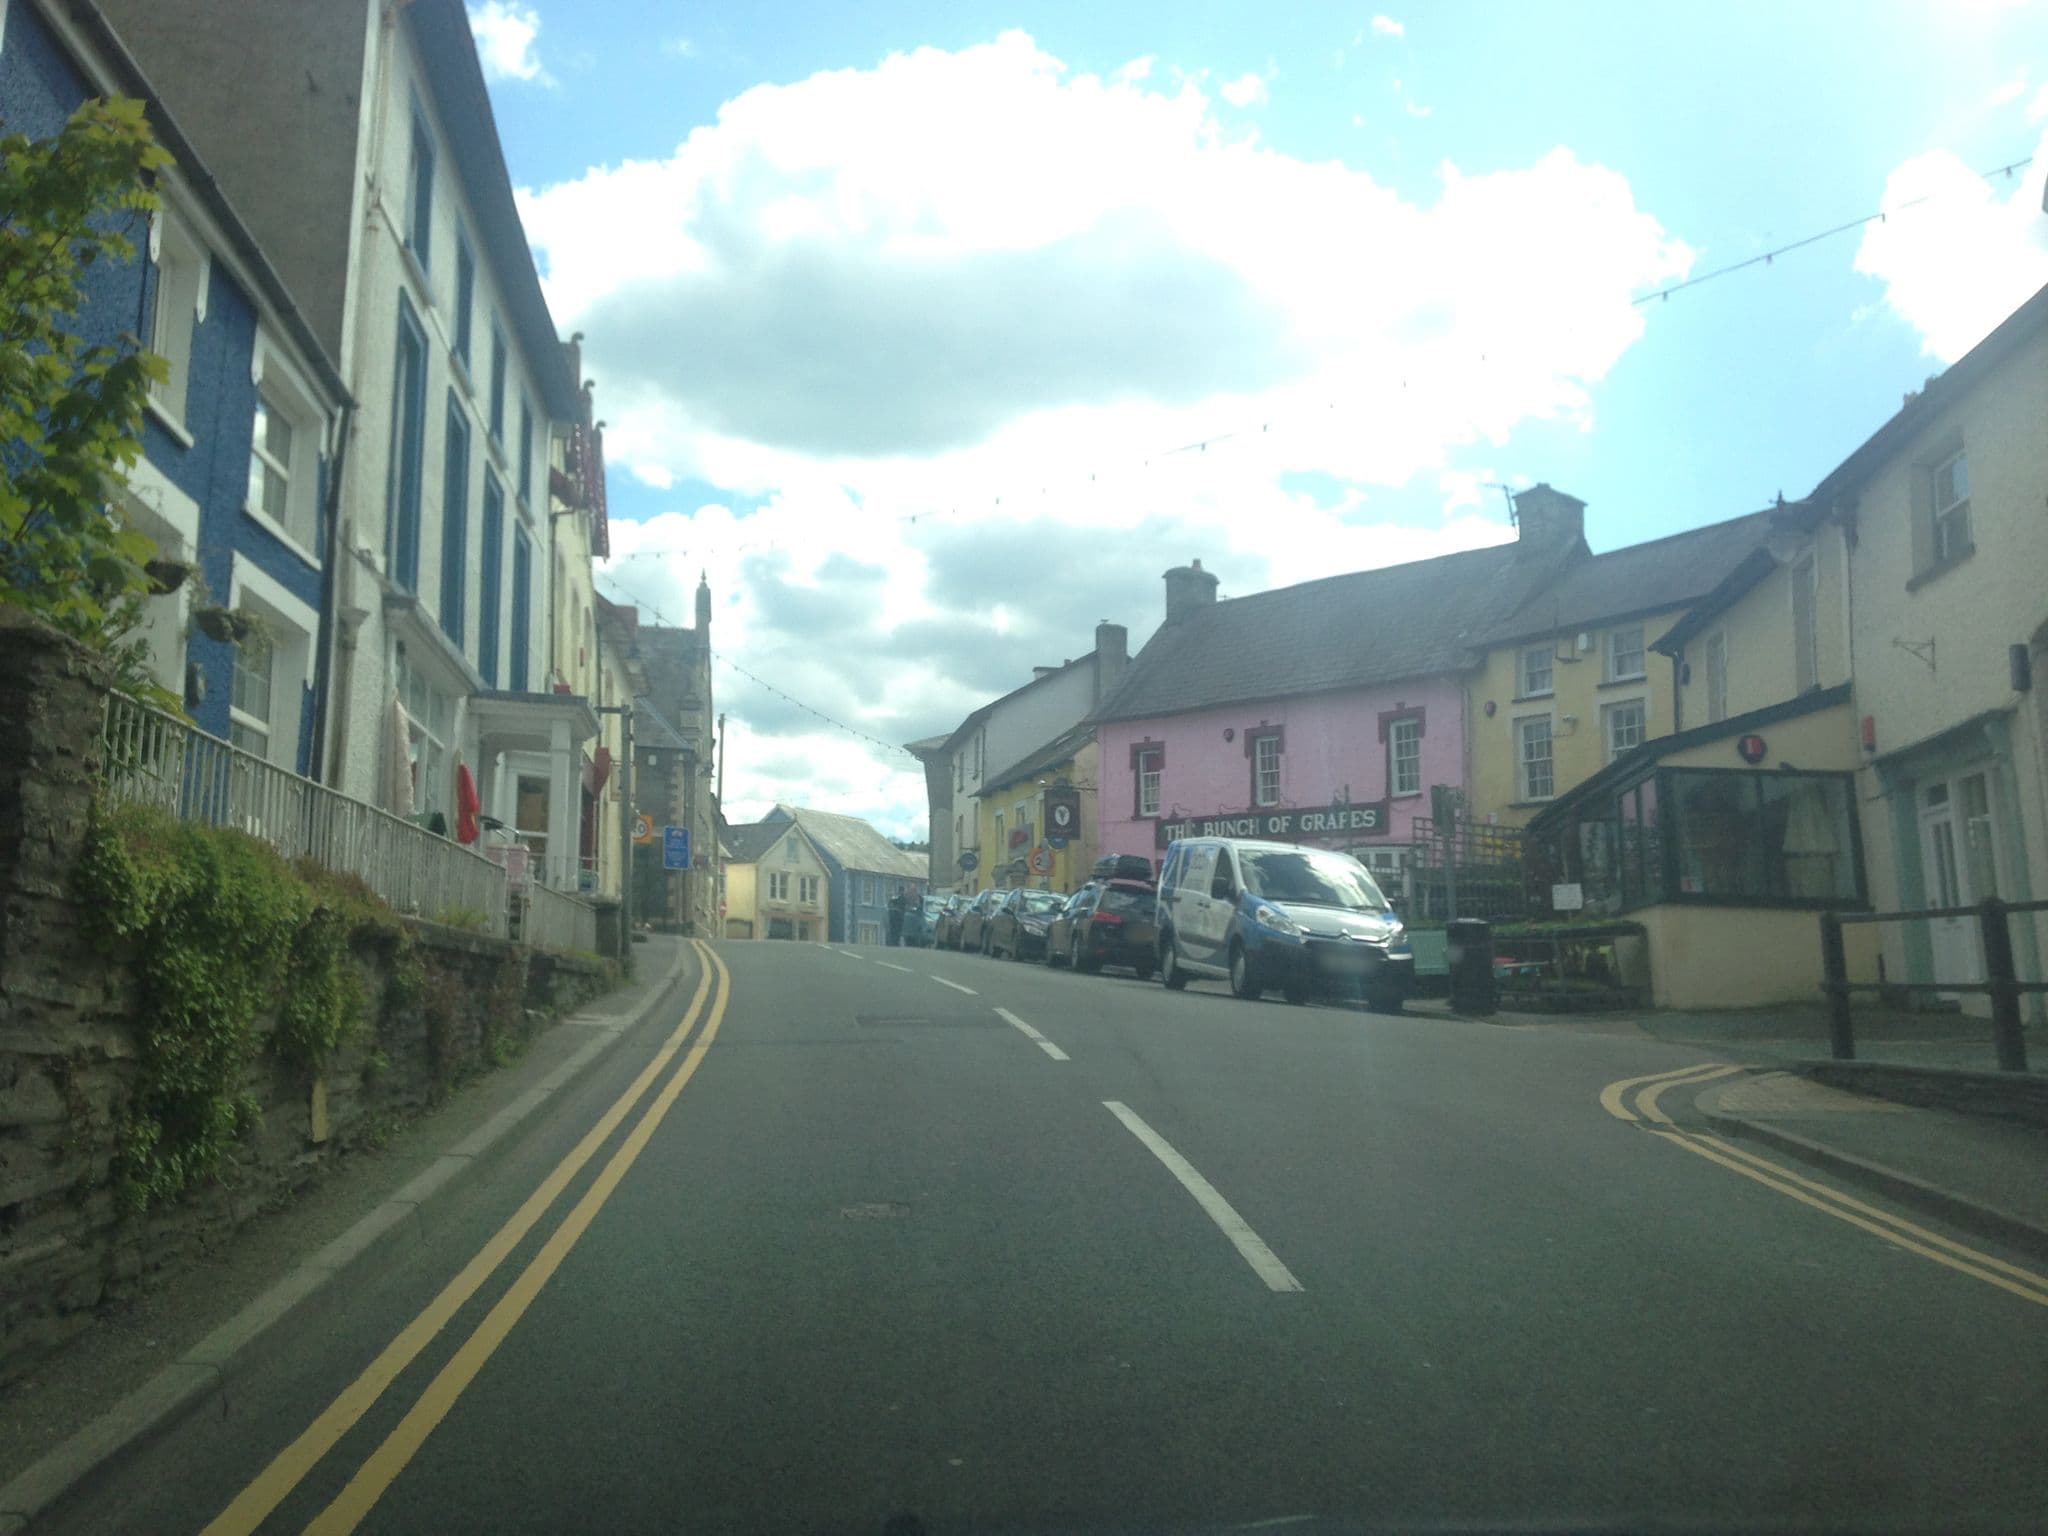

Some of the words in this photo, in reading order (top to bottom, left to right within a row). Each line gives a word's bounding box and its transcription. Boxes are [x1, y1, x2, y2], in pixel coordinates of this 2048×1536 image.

[1204, 818, 1260, 836] BUNCH
[1268, 815, 1292, 833] OF
[1300, 809, 1376, 831] GRAPES
